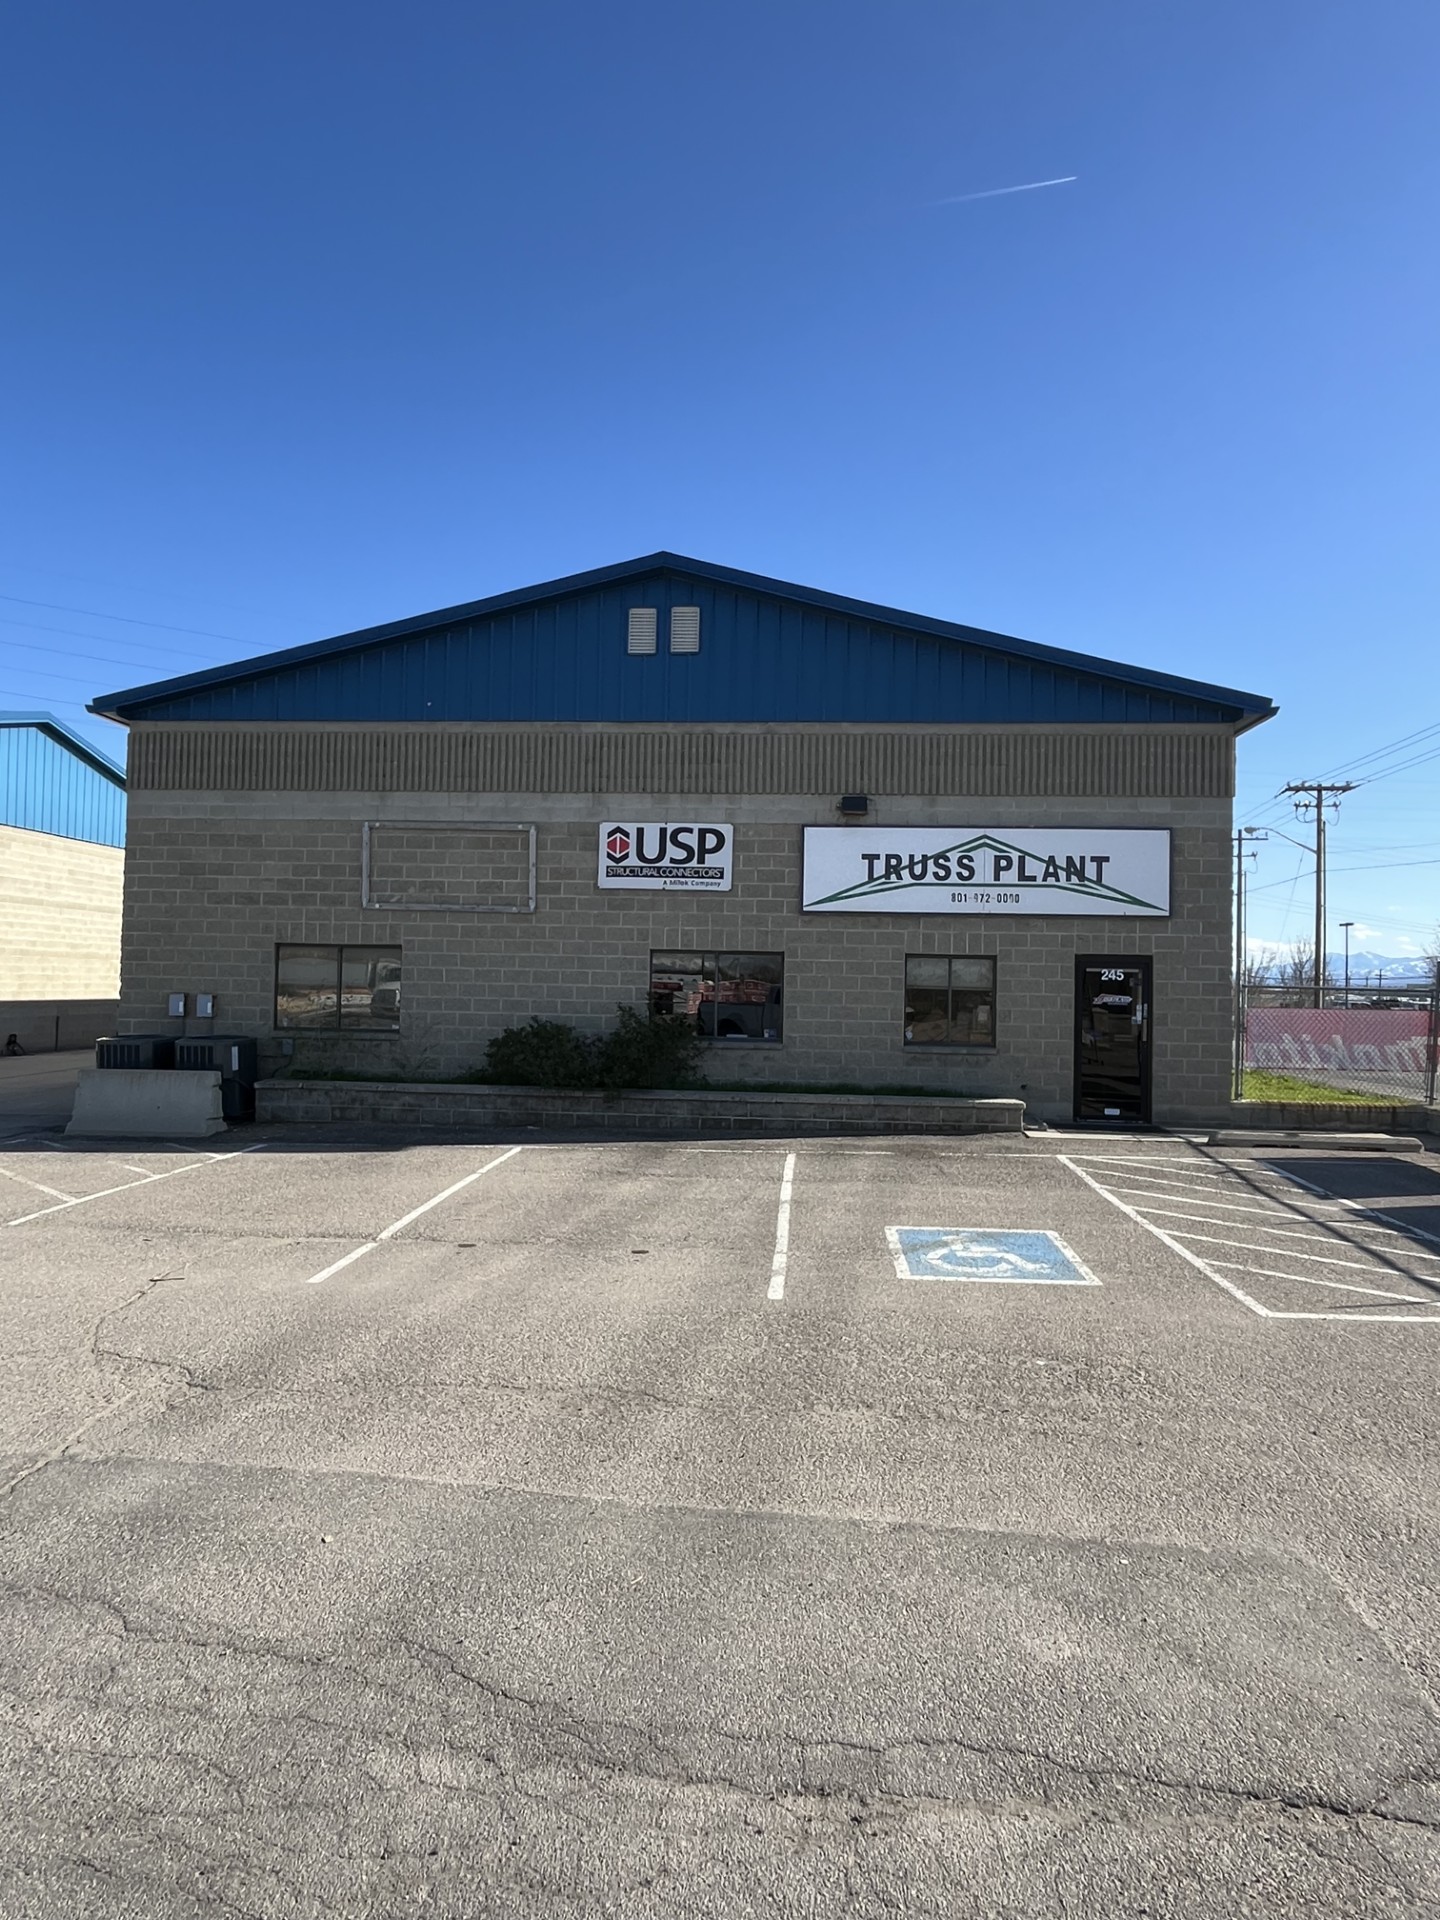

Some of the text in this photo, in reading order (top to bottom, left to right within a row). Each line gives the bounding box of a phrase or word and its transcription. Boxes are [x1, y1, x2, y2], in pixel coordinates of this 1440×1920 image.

[636, 827, 726, 865] USP
[607, 866, 721, 878] STRUCTURAL CONNECTORS
[861, 853, 1110, 884] TRUSS PLANT
[690, 880, 721, 888] Company
[1101, 969, 1125, 981] 245
